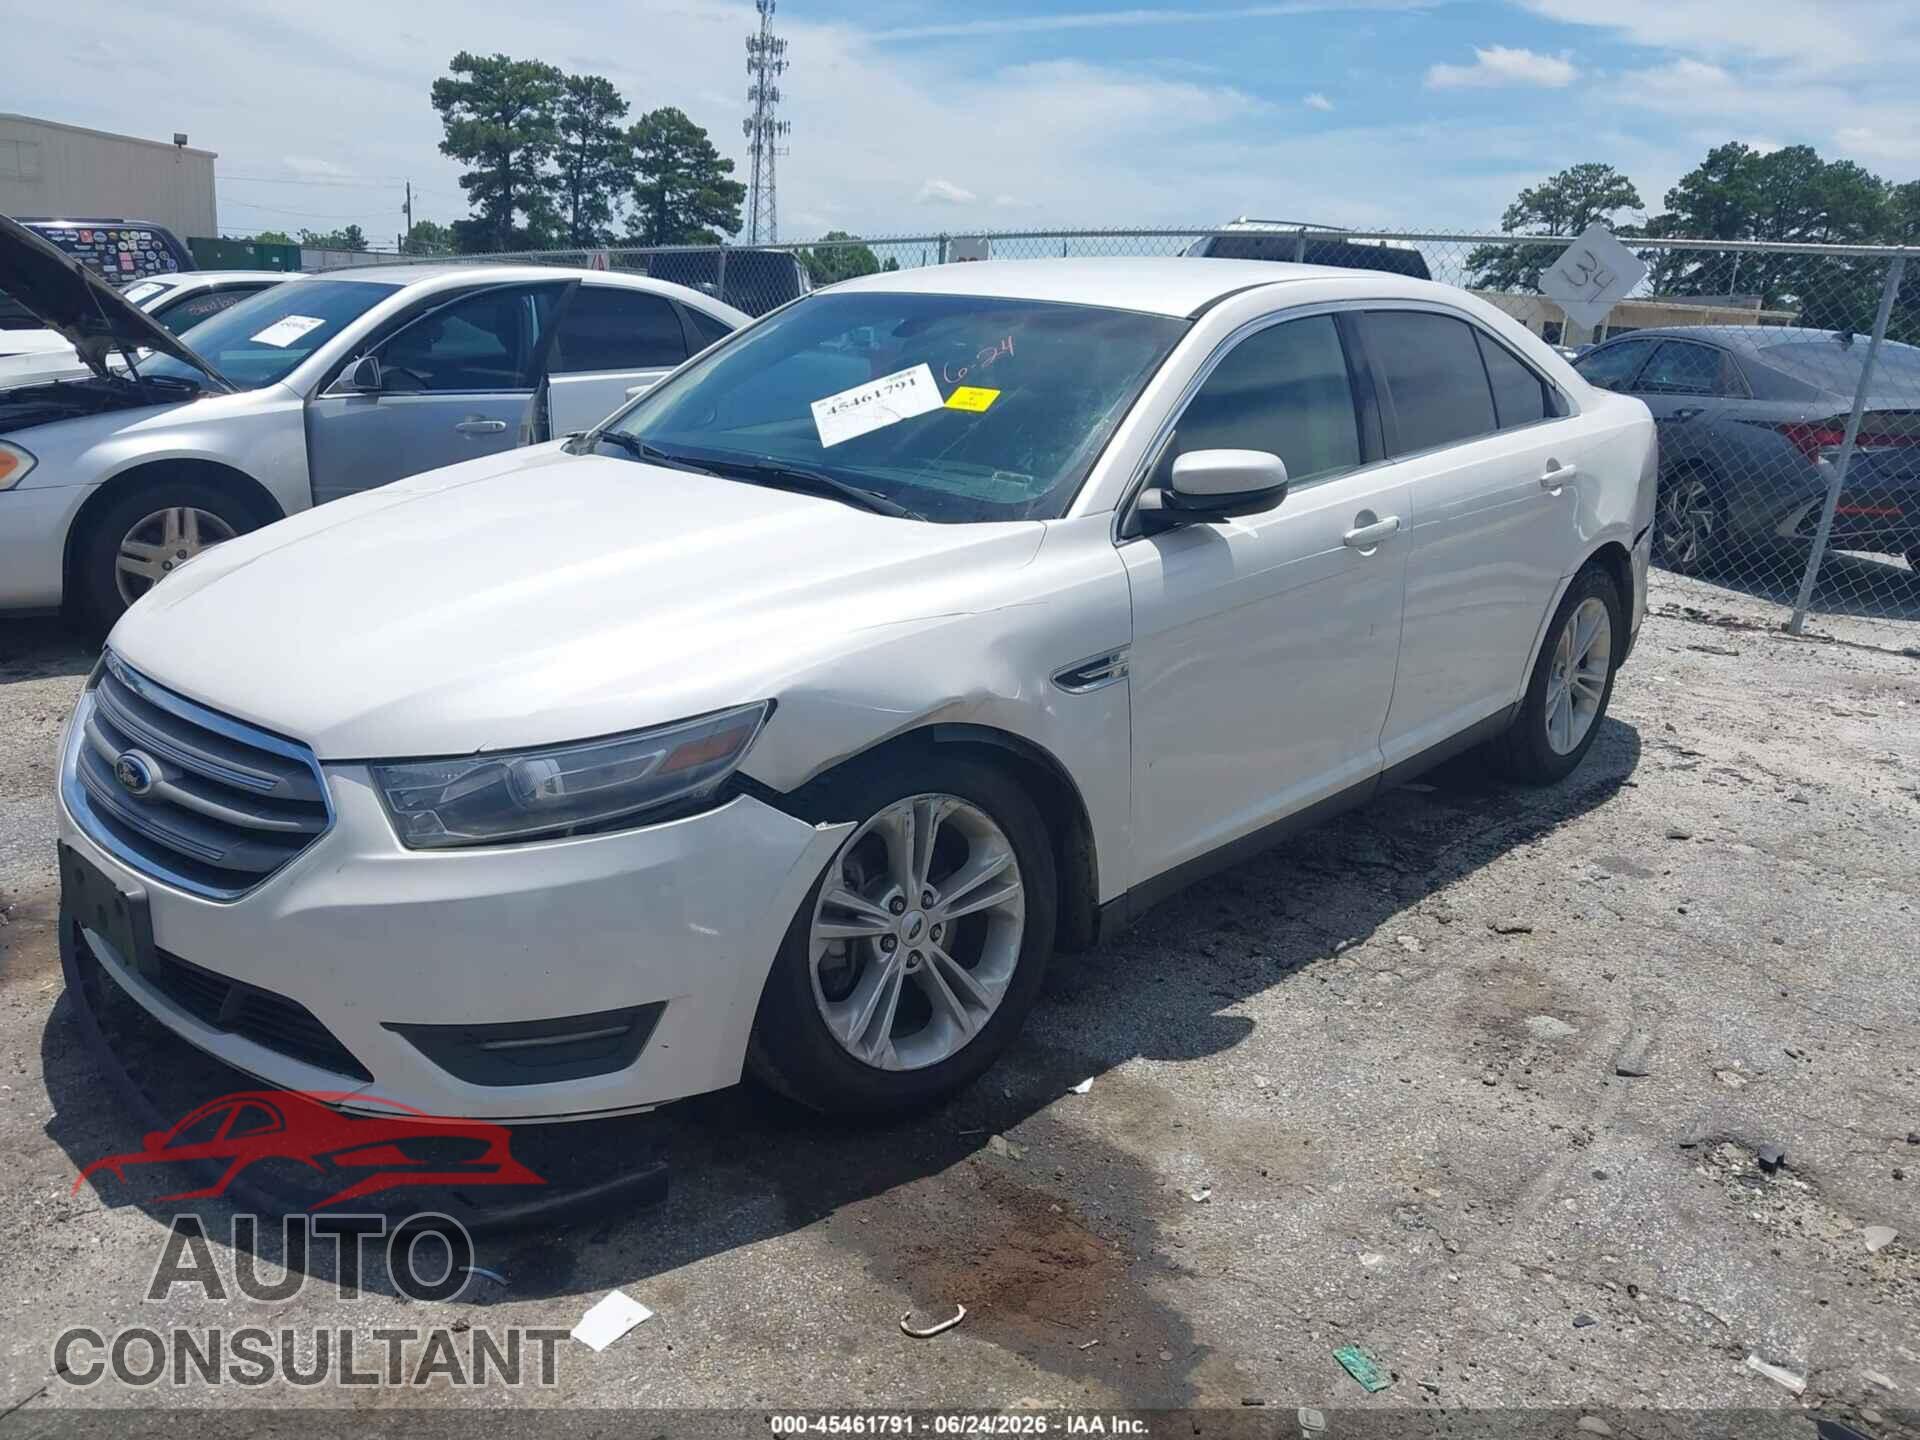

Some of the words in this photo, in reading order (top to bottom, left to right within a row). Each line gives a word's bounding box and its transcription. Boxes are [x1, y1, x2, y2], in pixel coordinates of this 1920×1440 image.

[1560, 249, 1617, 305] 34
[943, 335, 1015, 384] 6-24
[826, 377, 916, 415] 45461791
